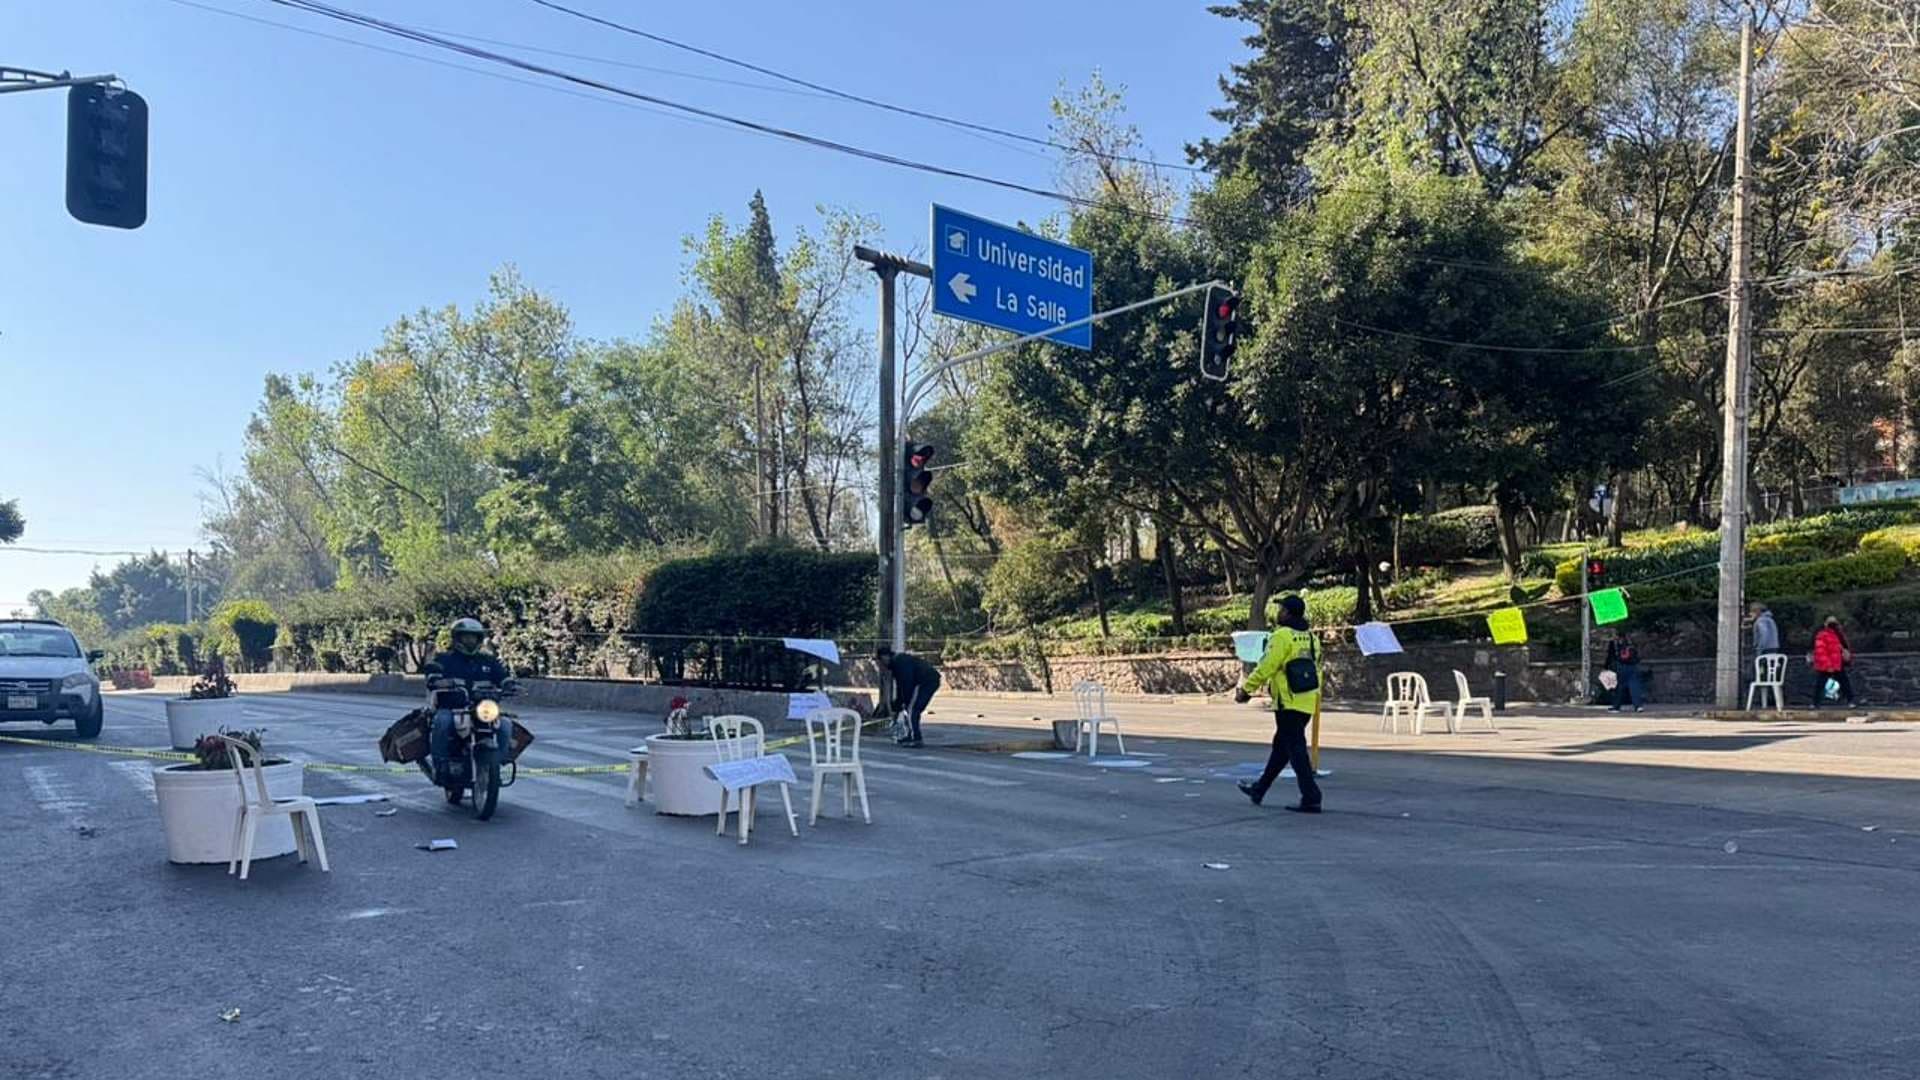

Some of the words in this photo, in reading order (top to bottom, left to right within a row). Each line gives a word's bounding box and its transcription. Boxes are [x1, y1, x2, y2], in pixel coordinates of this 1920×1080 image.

[978, 237, 1084, 289] Universidad
[996, 287, 1018, 313] La
[1026, 295, 1067, 325] Salle
